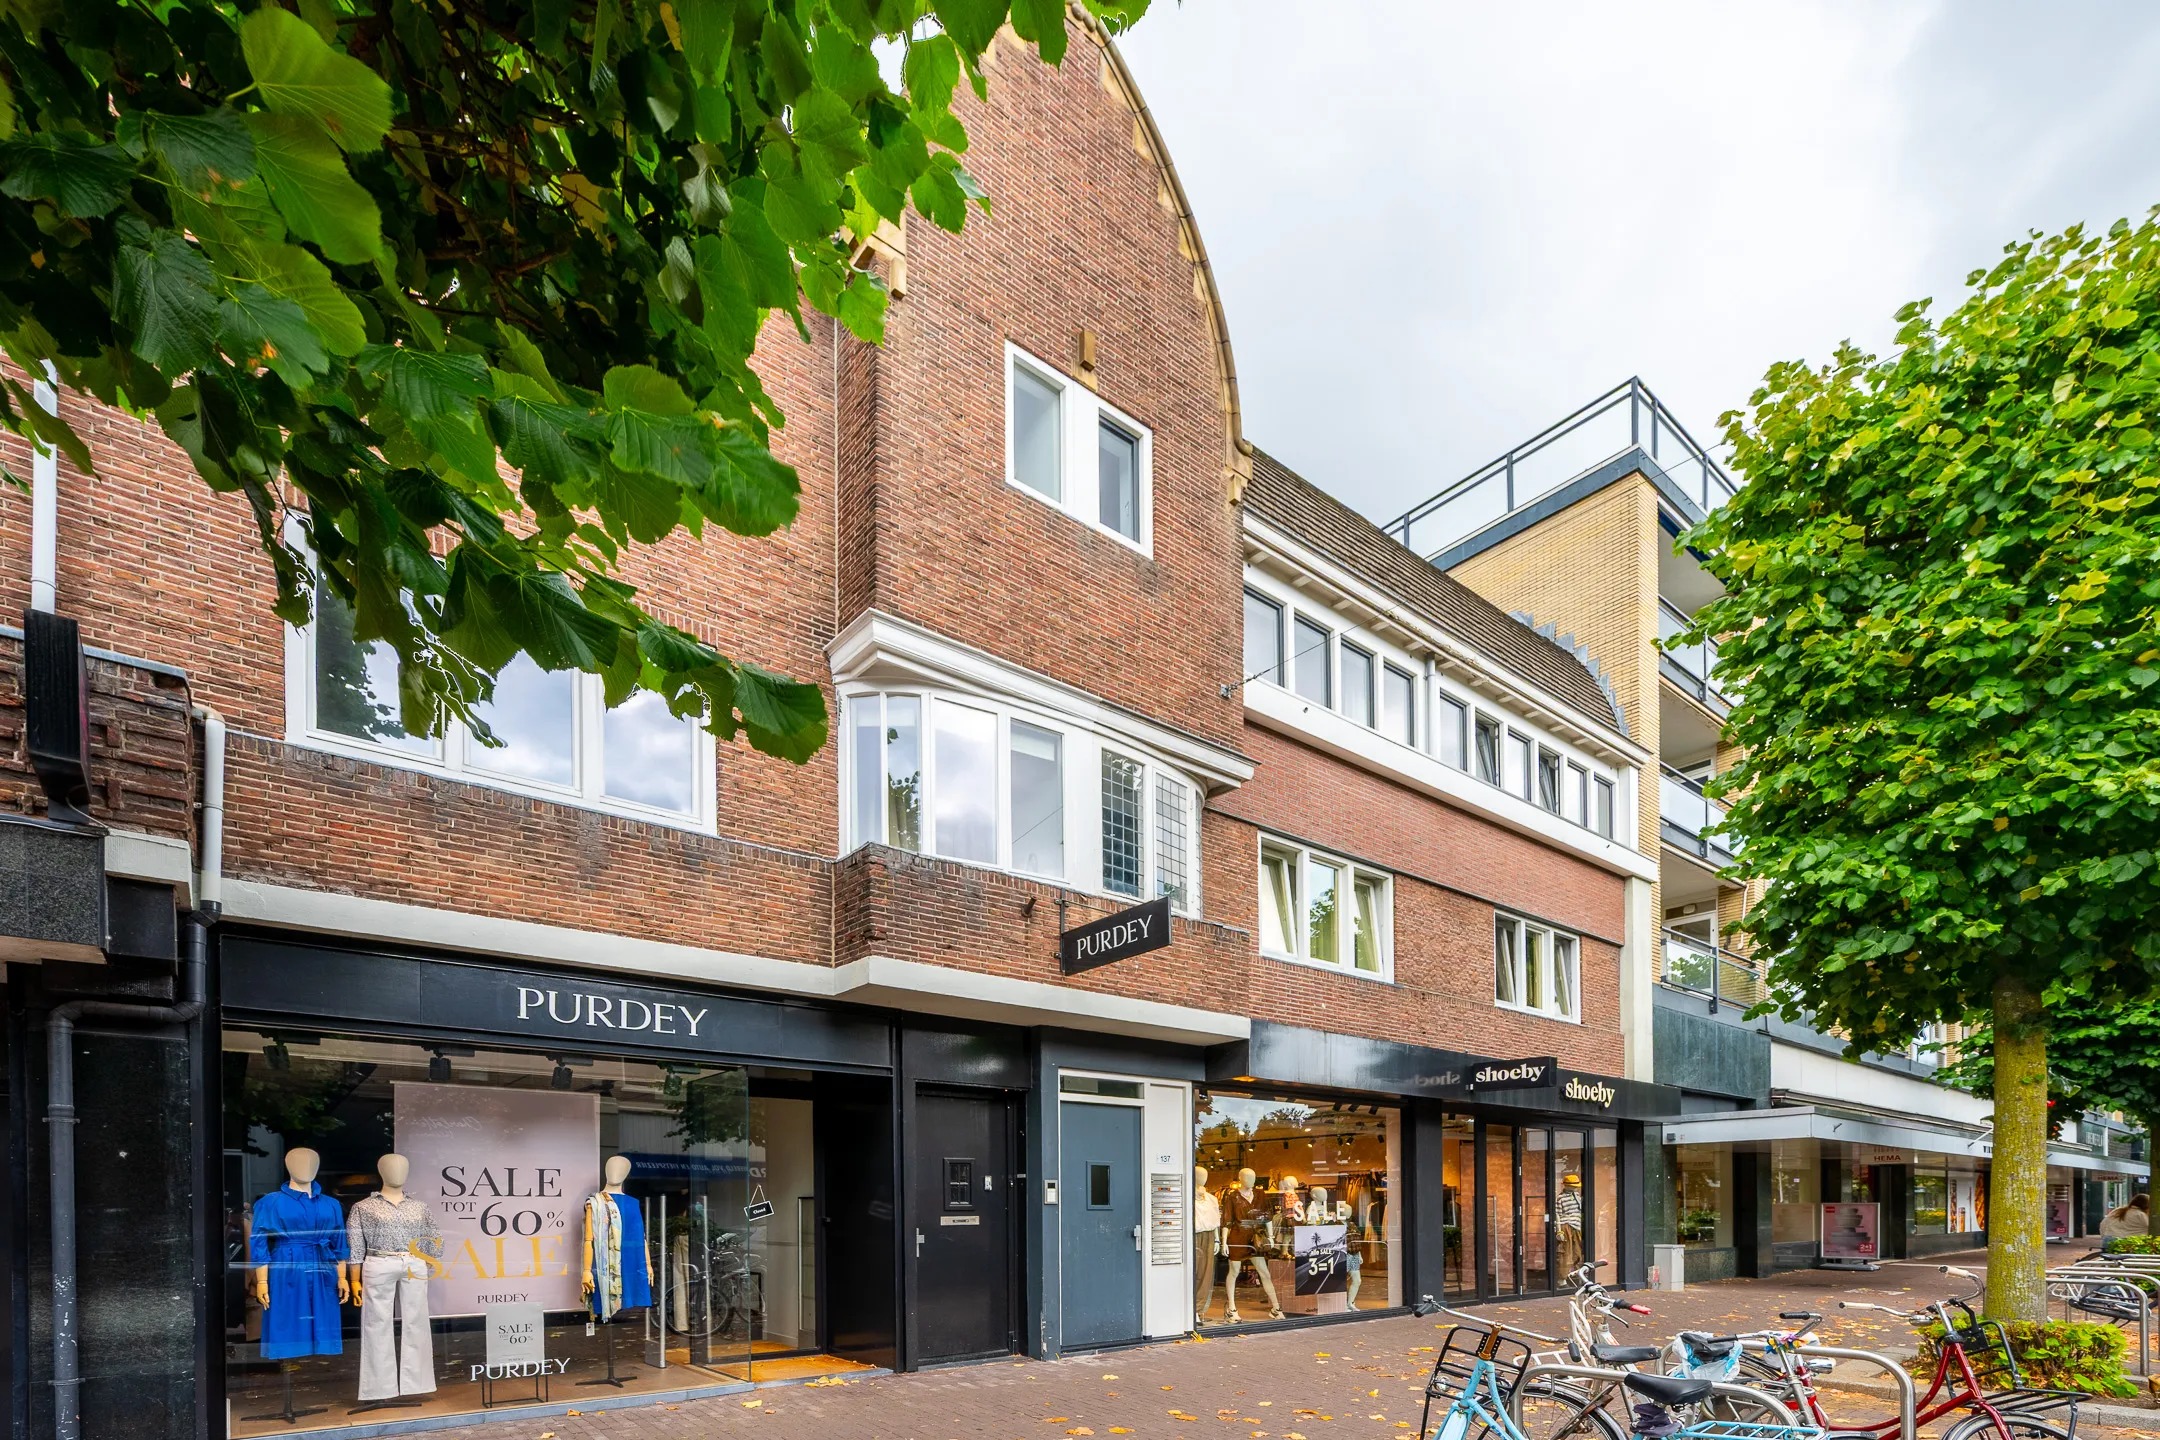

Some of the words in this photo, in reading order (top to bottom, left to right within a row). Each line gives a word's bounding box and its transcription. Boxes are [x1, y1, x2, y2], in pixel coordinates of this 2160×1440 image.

[1076, 914, 1152, 960] PURDEY
[516, 986, 708, 1037] PURDEY
[1475, 1063, 1546, 1083] shoeby
[1565, 1077, 1615, 1108] shoeby
[1160, 1155, 1170, 1163] 137
[441, 1165, 562, 1197] SALE
[441, 1202, 477, 1212] TOT
[1293, 1200, 1347, 1221] SALE
[407, 1236, 568, 1280] SALE
[1308, 1257, 1334, 1275] 3=1
[477, 1294, 528, 1303] PURDEY
[498, 1324, 533, 1334] SALE
[470, 1357, 571, 1381] PURDEY
